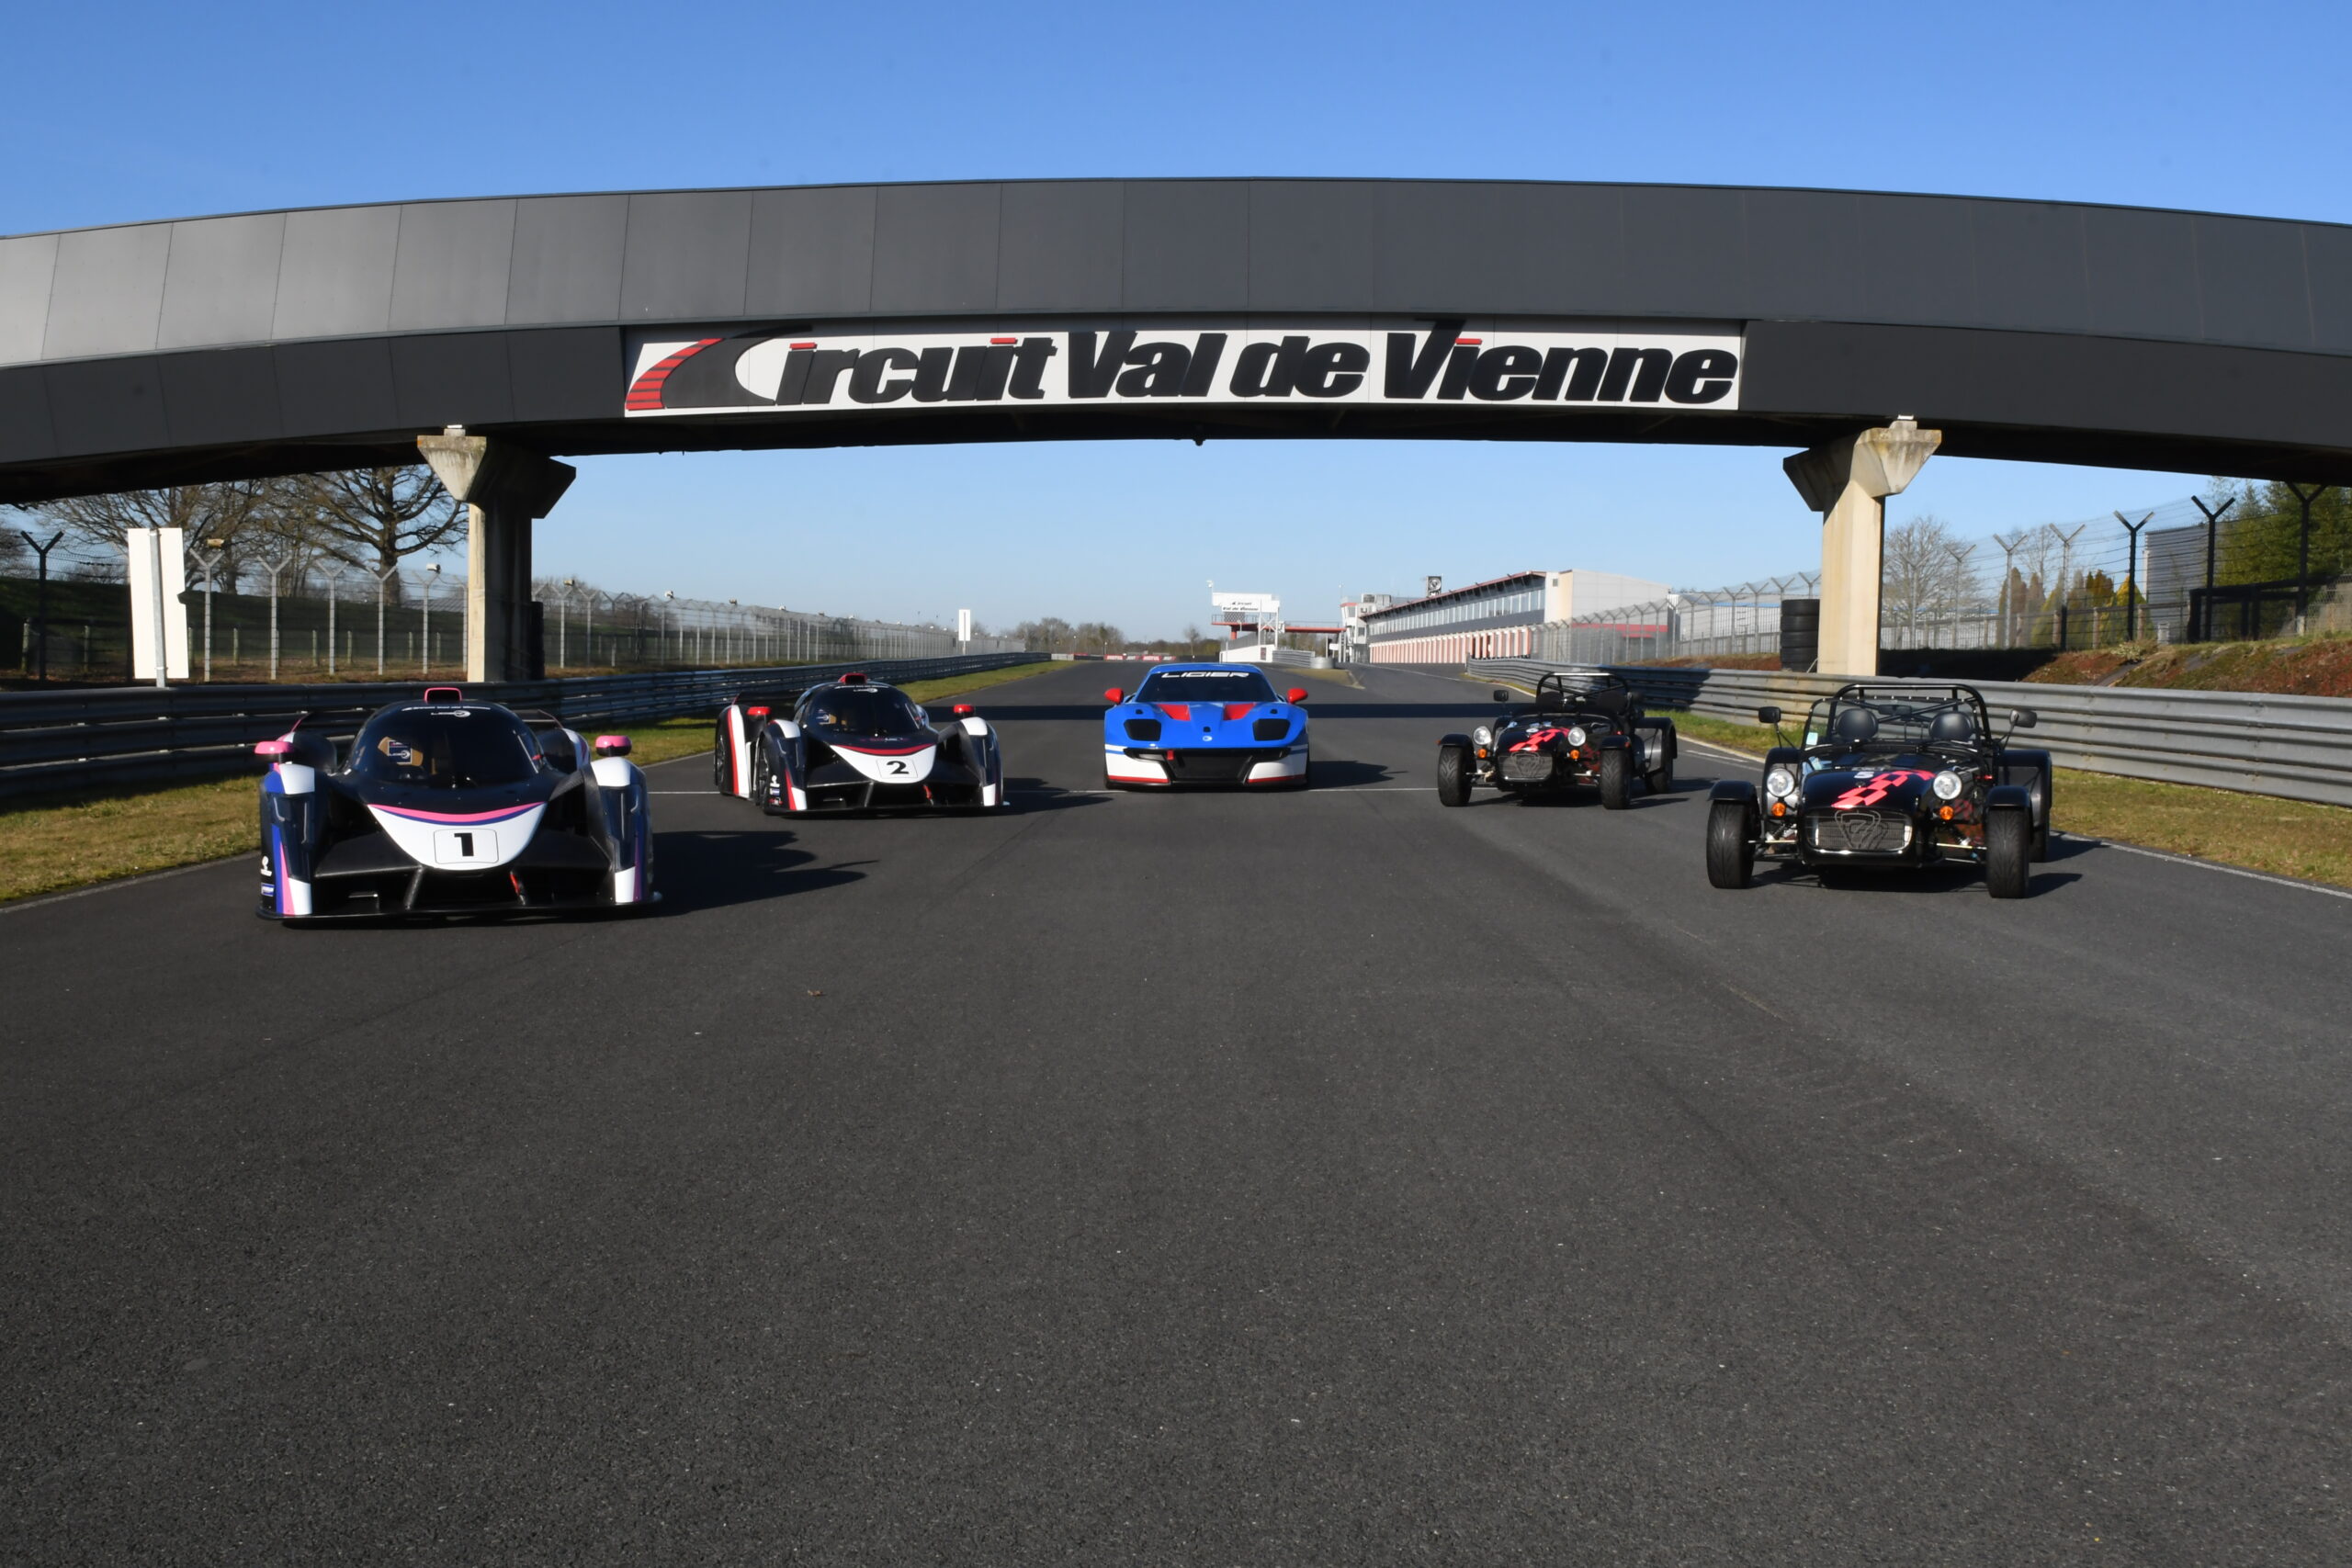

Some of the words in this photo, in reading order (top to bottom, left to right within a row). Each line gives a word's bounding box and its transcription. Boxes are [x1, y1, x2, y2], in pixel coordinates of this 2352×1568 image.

[626, 324, 1057, 412] Circuit
[1068, 331, 1229, 399] Val
[1229, 334, 1372, 399] de
[1384, 319, 1739, 405] Vienne
[886, 760, 910, 775] 2
[453, 831, 475, 857] 1
